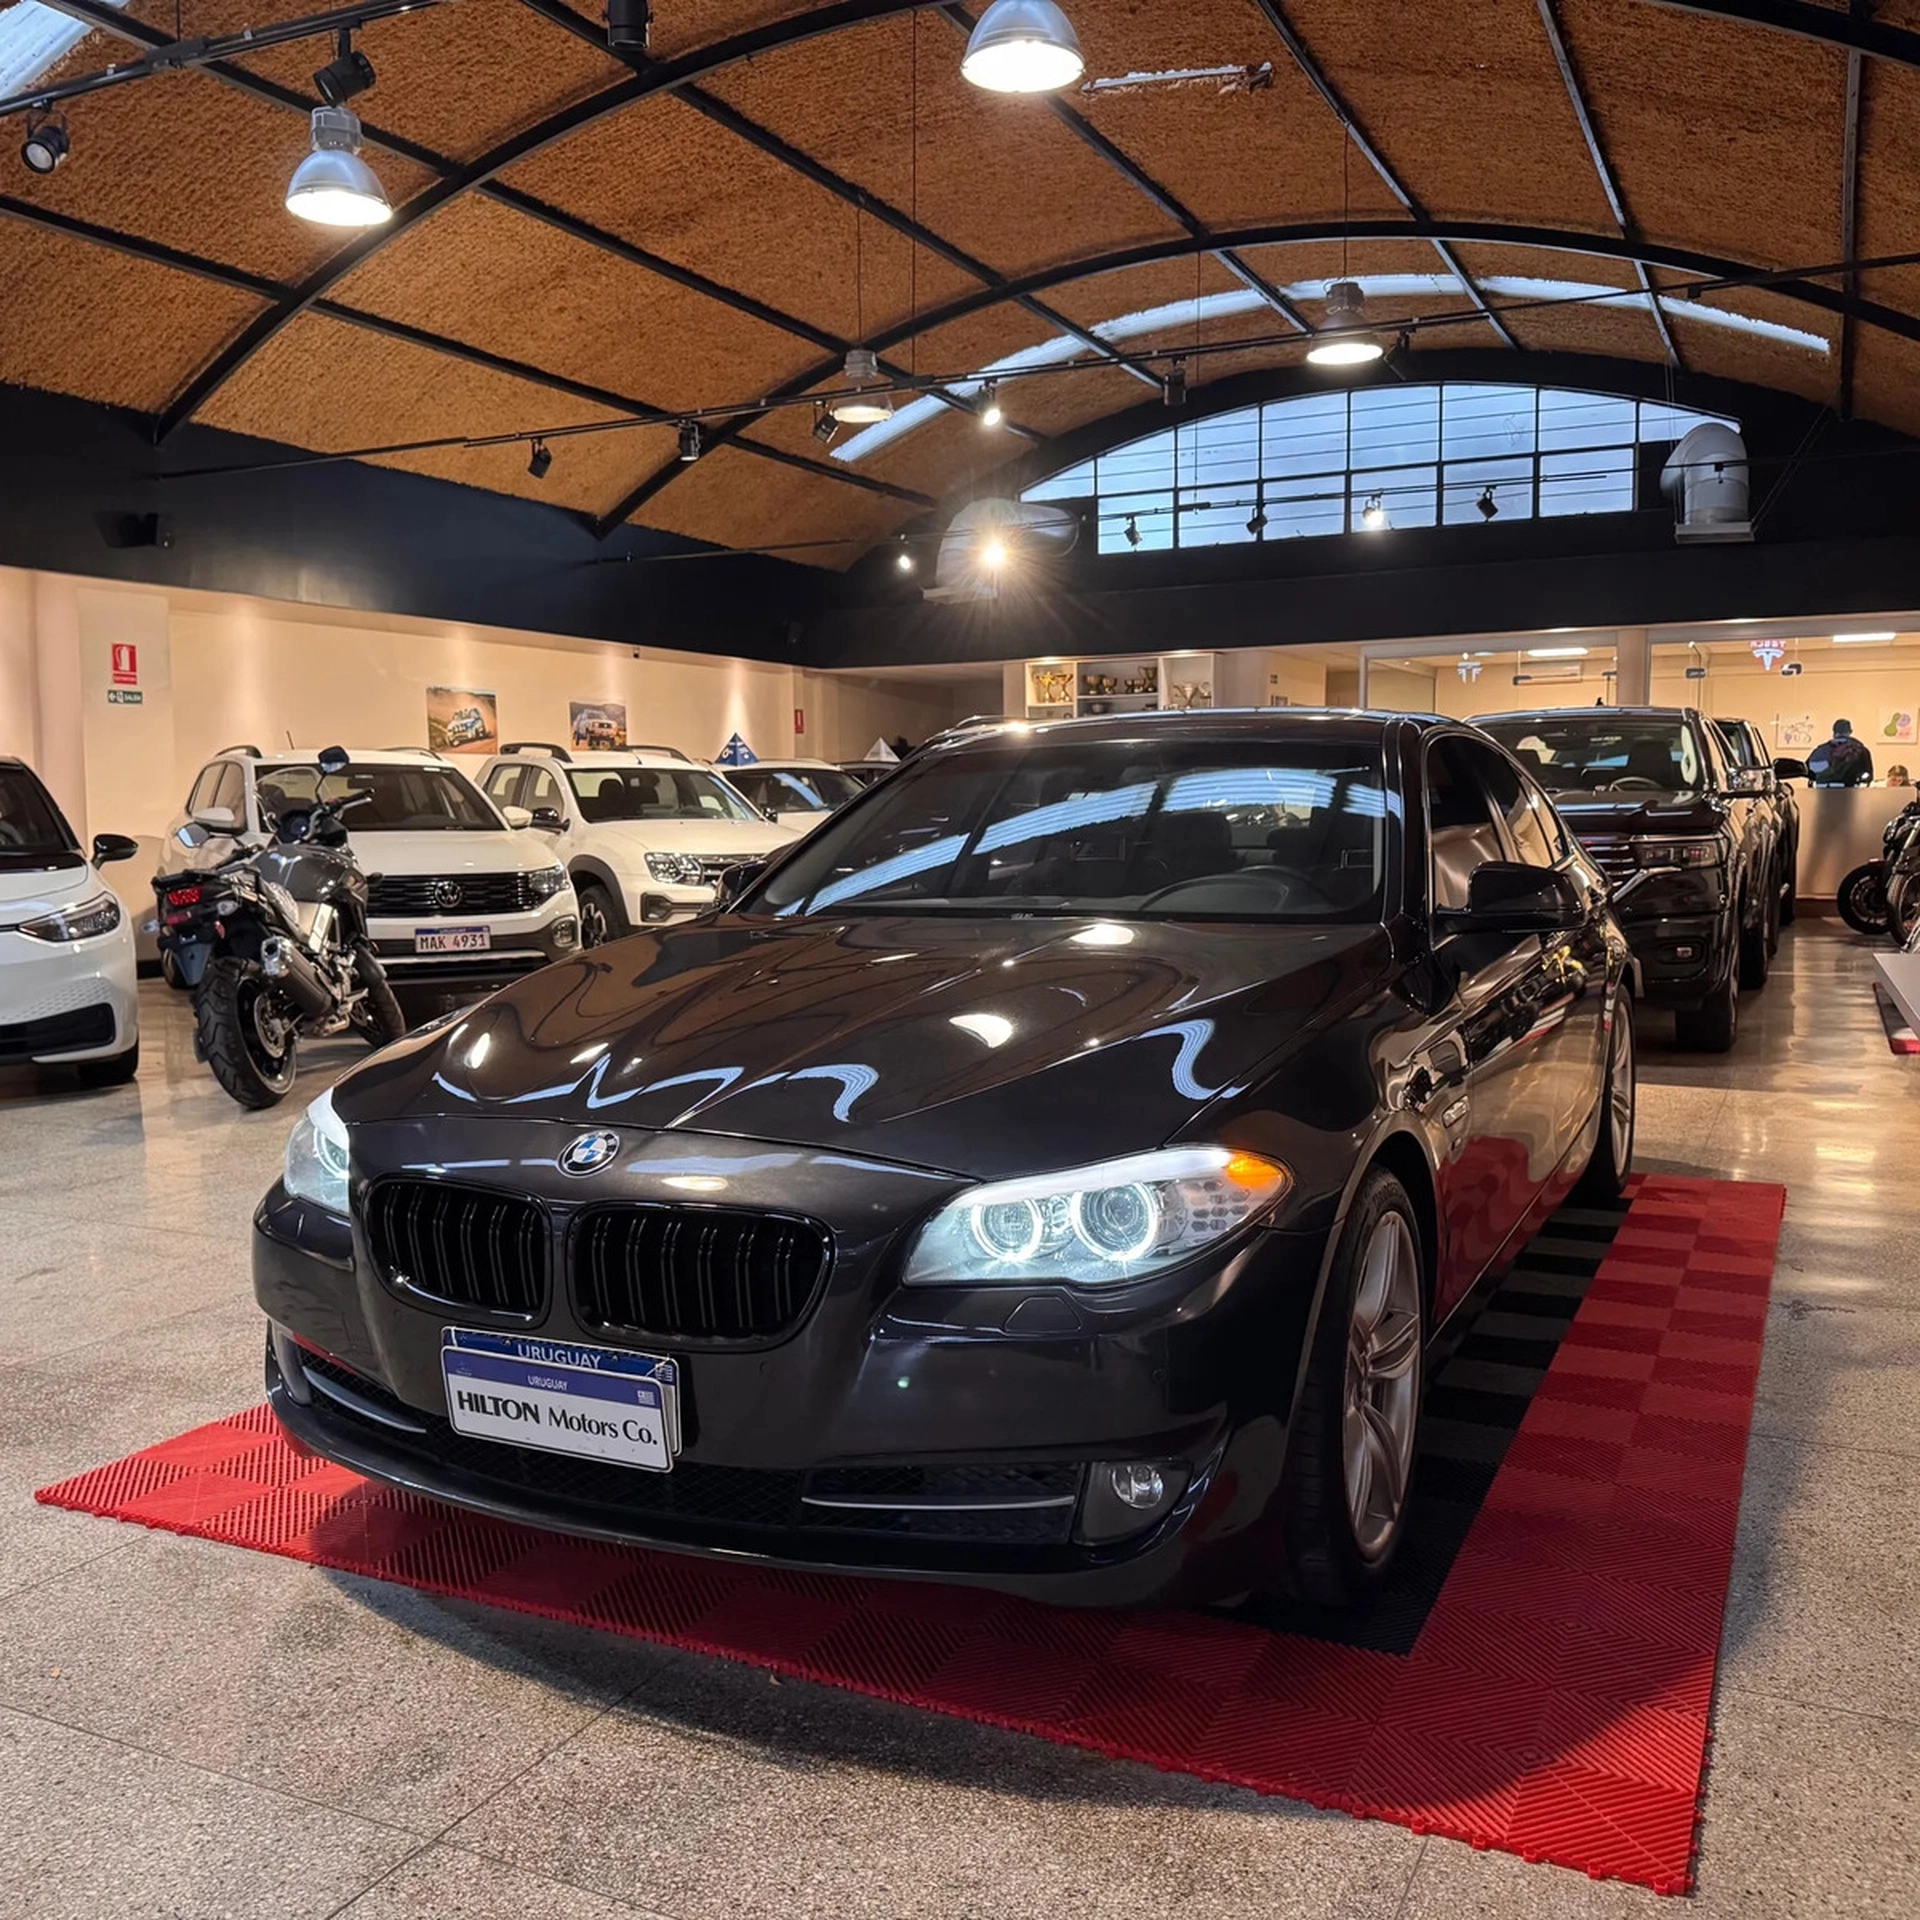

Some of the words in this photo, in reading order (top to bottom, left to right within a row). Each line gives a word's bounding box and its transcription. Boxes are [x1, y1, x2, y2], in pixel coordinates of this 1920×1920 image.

[420, 935, 447, 950] MAK
[452, 933, 486, 948] 4931
[517, 1343, 601, 1369] URUGUAY
[527, 1375, 569, 1391] URUGUAY
[457, 1390, 541, 1425] HILTON
[548, 1406, 619, 1439] Motors
[622, 1419, 658, 1446] Co.
